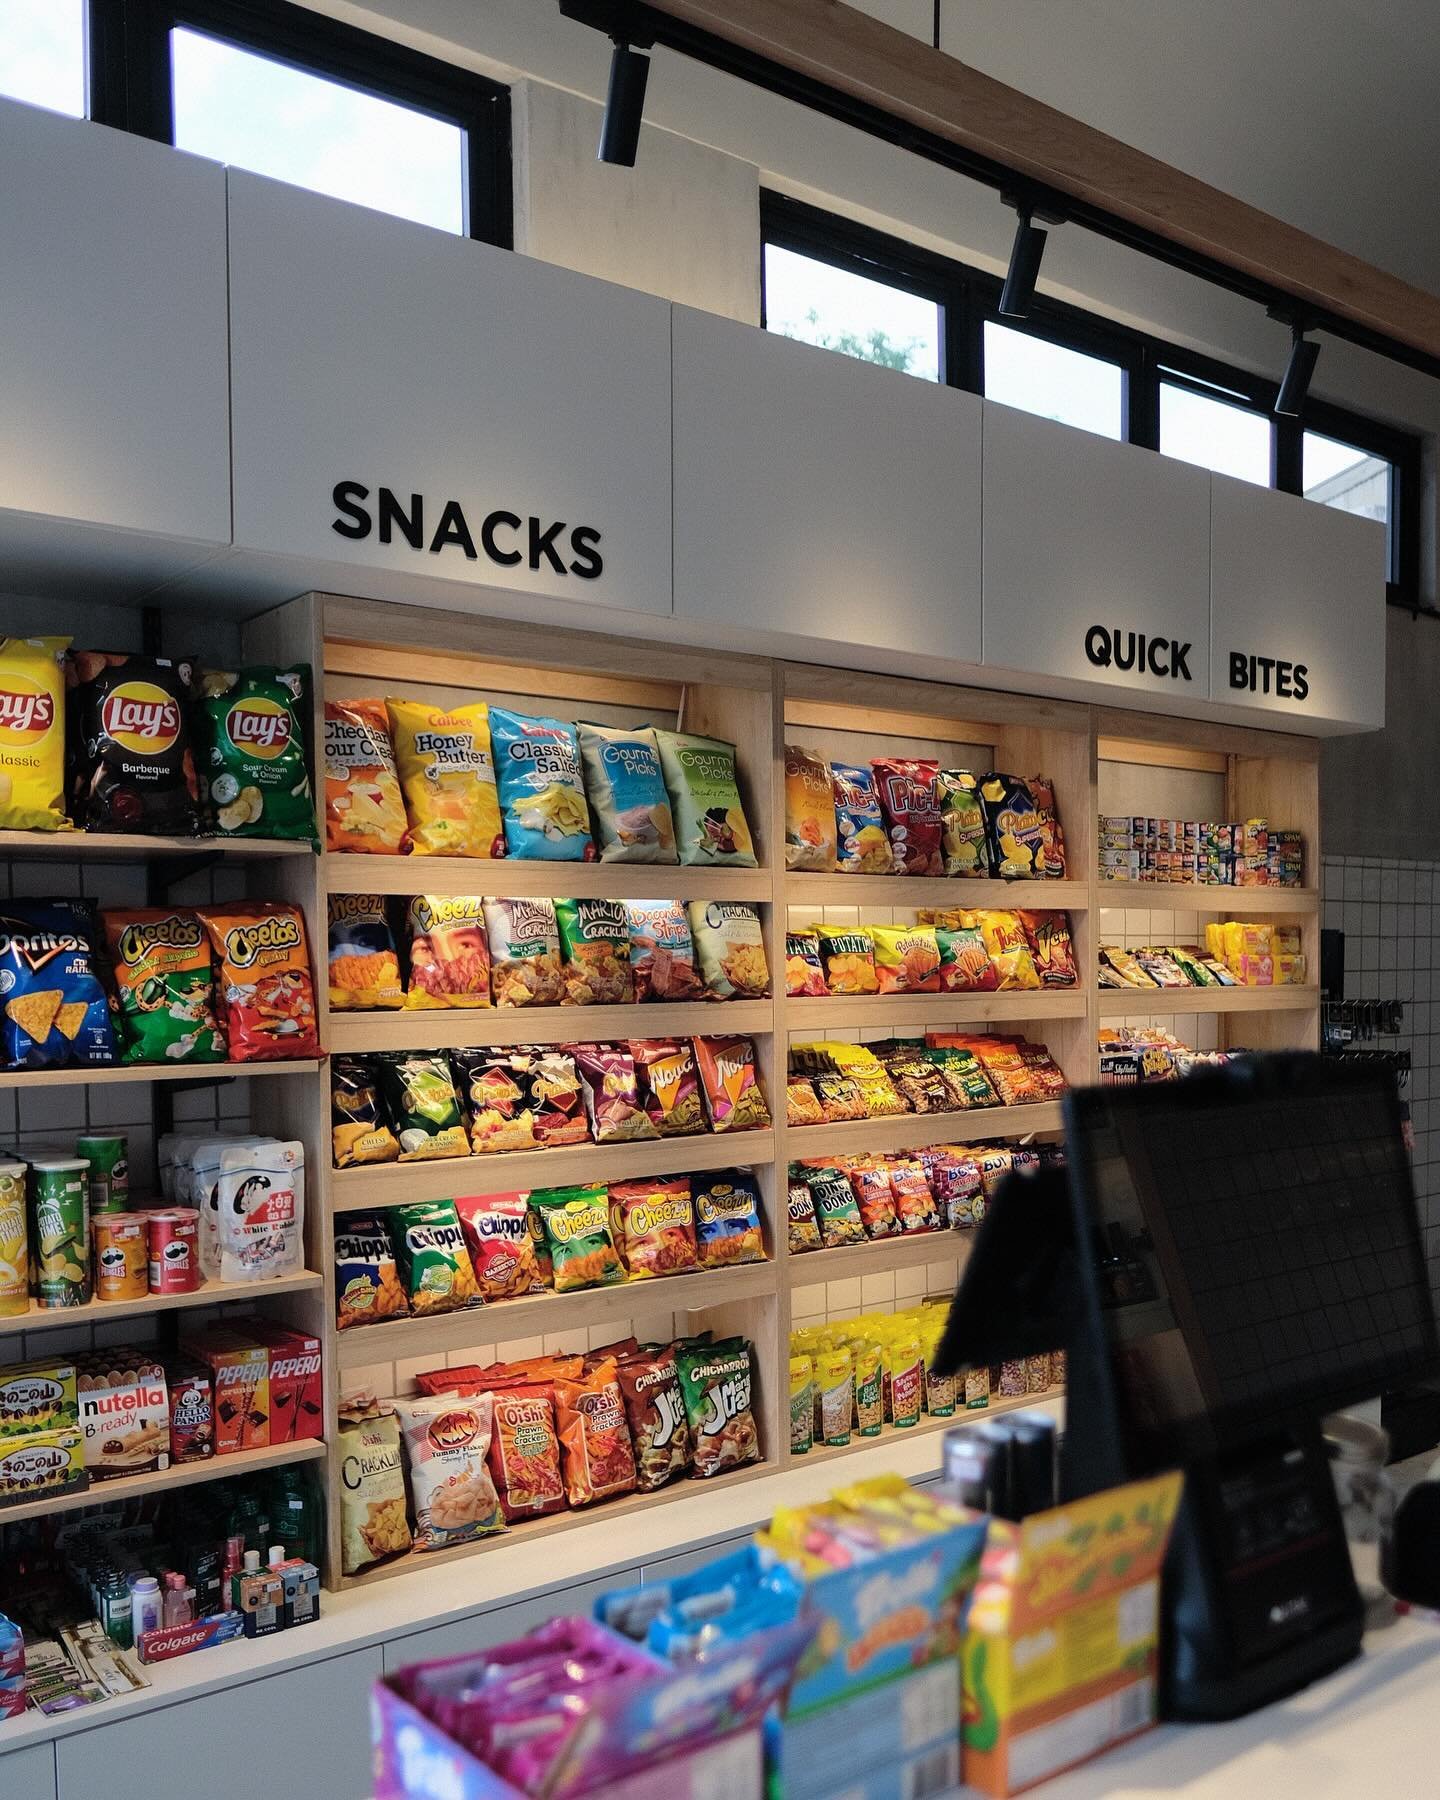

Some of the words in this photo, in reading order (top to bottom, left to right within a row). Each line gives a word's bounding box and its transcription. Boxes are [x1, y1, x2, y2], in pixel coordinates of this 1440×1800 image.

[332, 480, 604, 579] SNACKS
[1085, 625, 1192, 681] QUICK
[1229, 651, 1309, 701] BITES
[0, 694, 51, 730] ay's
[109, 696, 177, 737] Lay's
[428, 713, 473, 728] Calbee
[232, 711, 289, 746] Lay's
[325, 741, 355, 756] our
[417, 734, 473, 753] Honey
[510, 741, 573, 760] Classic
[0, 753, 41, 768] lassic
[437, 751, 486, 765] Butter
[603, 746, 659, 765] Gourm
[680, 752, 734, 767] Gourm
[122, 763, 170, 776] Barbeque
[243, 763, 262, 772] Sour
[264, 765, 288, 774] Cream
[624, 760, 657, 776] Picks
[699, 765, 734, 781] Picks
[786, 761, 826, 777] Gourm
[803, 776, 830, 794] Picks
[888, 777, 941, 812] Pic-
[1284, 833, 1302, 843] SPAM
[1285, 863, 1302, 873] SPAM
[652, 920, 689, 942] Strips
[119, 915, 201, 967] Cheetos
[226, 917, 301, 968] Cheetos
[717, 1042, 754, 1088] Nova
[650, 1057, 694, 1093] Nova
[697, 1192, 754, 1225] Cheezy
[822, 1190, 854, 1213] DONG
[630, 1201, 692, 1236] Cheezy
[243, 1225, 269, 1235] White
[215, 1362, 269, 1386] PEPERO
[270, 1354, 321, 1380] PEPERO
[84, 1386, 164, 1417] nutella
[585, 1391, 619, 1414] Oishi
[174, 1413, 211, 1427] PANDA
[176, 1405, 211, 1418] HELLO
[506, 1406, 545, 1427] Oishi
[592, 1410, 620, 1423] Prawn
[85, 1411, 138, 1439] B-ready
[517, 1426, 543, 1435] Prawn
[513, 1434, 548, 1445] Crackers
[431, 1448, 460, 1458] Yummy
[462, 1444, 485, 1453] Flakes
[143, 1622, 193, 1638] Colgate
[148, 1631, 206, 1654] Colgate
